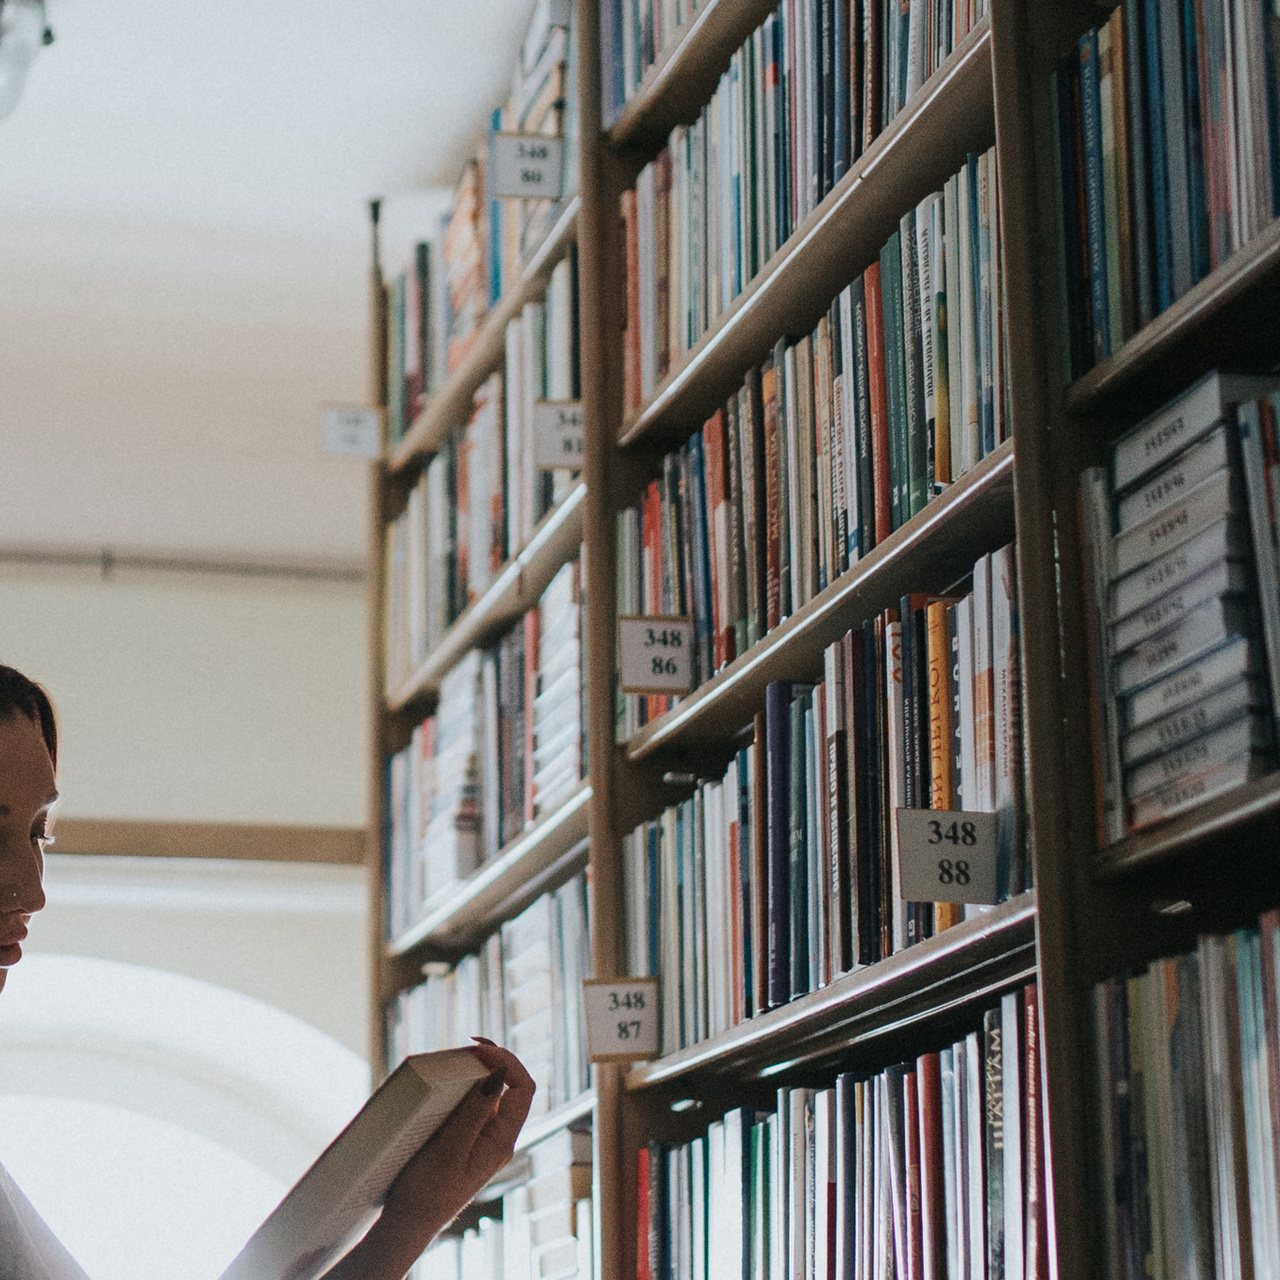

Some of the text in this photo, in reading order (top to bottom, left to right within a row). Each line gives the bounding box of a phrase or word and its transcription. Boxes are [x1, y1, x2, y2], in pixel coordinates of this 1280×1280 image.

[515, 144, 549, 161] 348
[645, 629, 683, 648] 348
[652, 656, 678, 675] 86
[928, 820, 976, 846] 348
[939, 860, 970, 885] 88
[608, 992, 645, 1012] 348
[616, 1022, 641, 1041] 87
[990, 1029, 1003, 1149] ШАТТАМ
